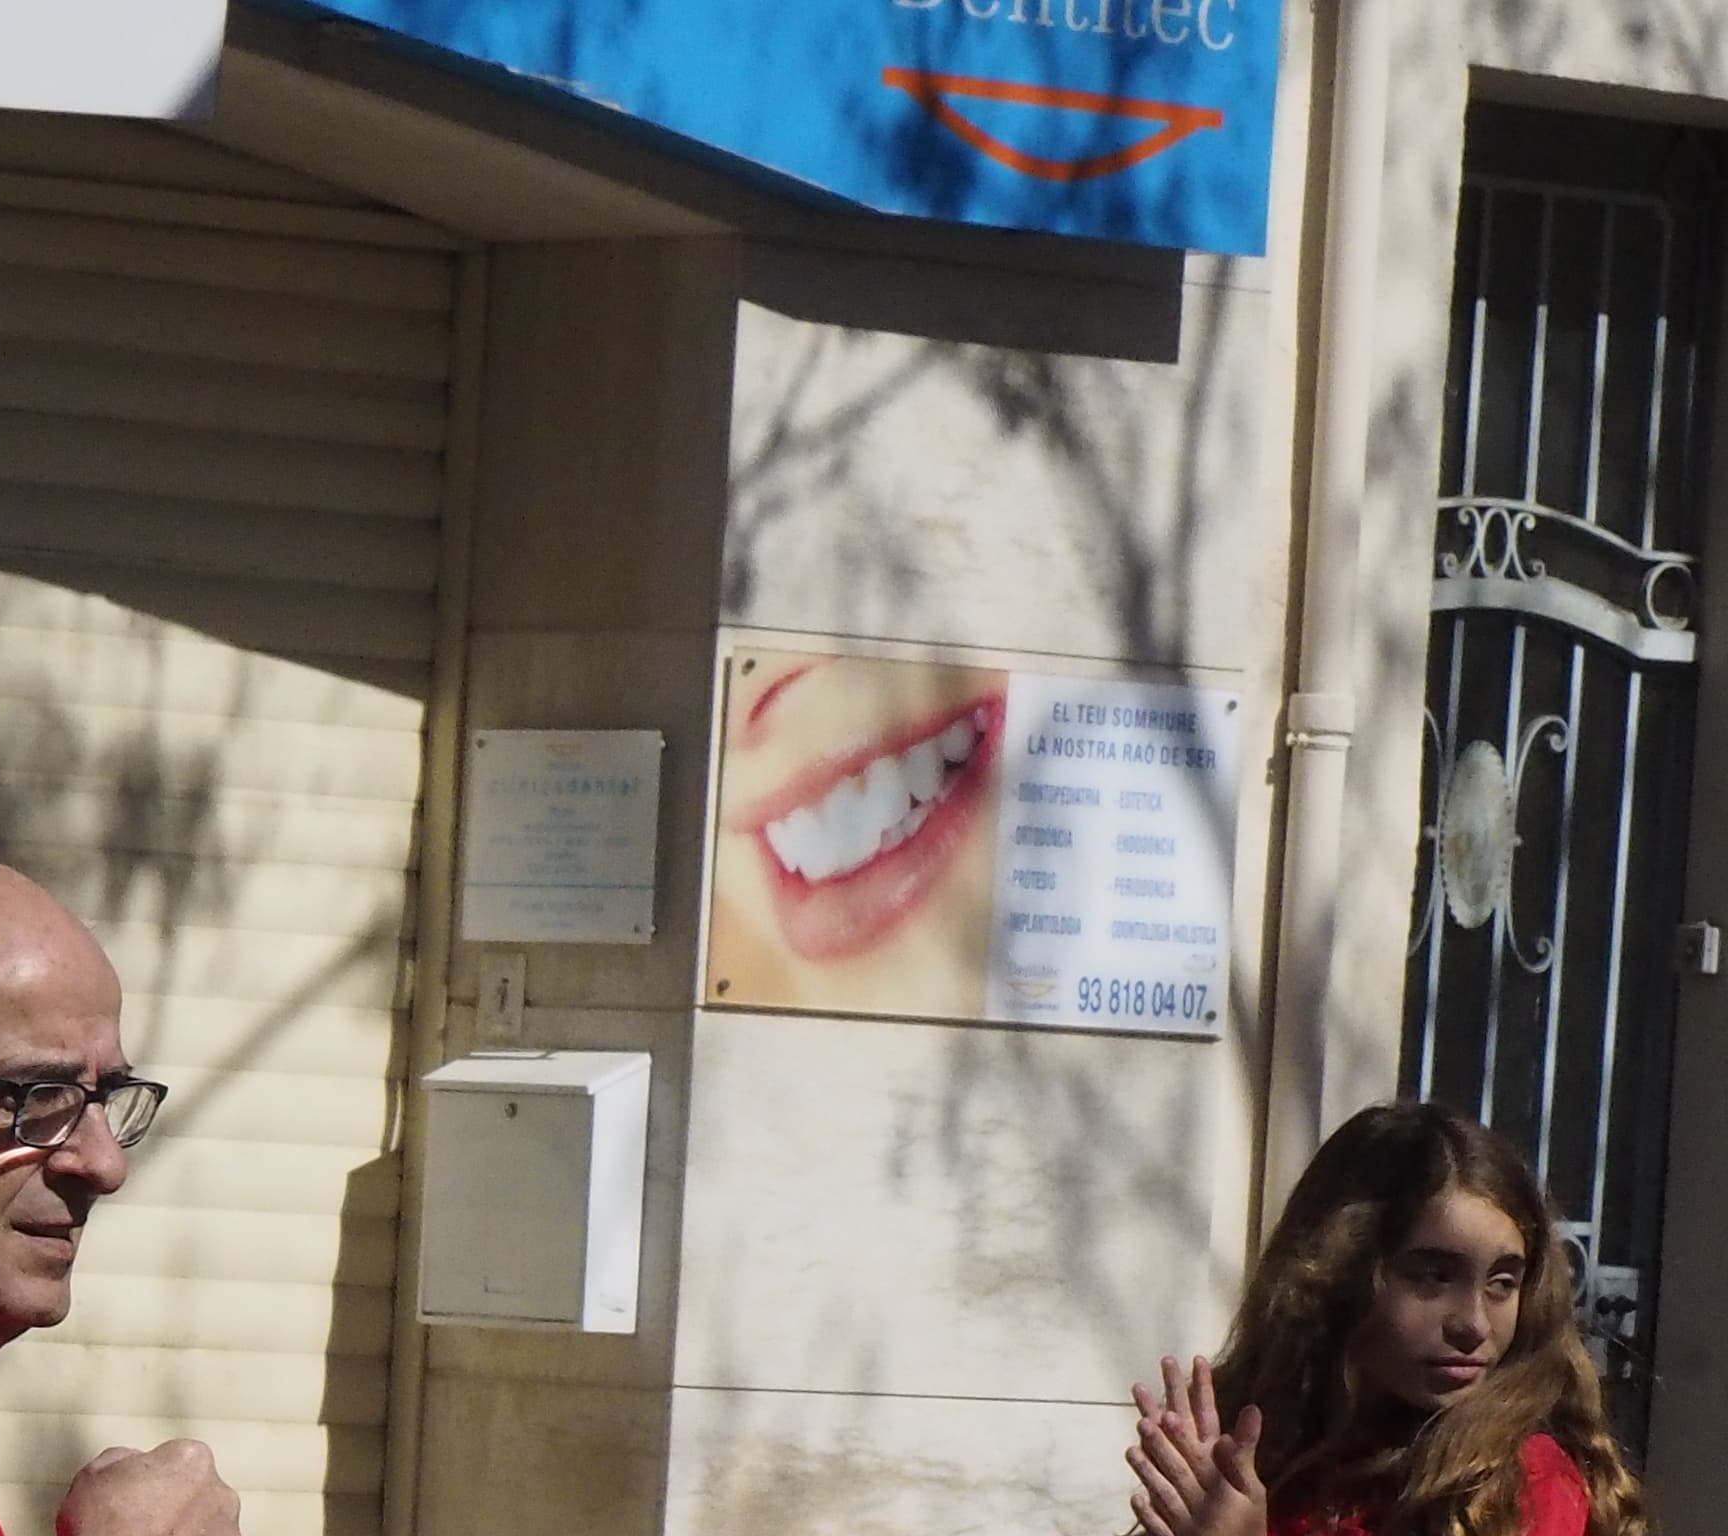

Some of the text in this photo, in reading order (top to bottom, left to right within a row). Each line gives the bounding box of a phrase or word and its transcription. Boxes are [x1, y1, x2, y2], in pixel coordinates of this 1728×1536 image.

[891, 0, 1235, 50] itec
[1052, 702, 1197, 734] EL TEU SOMRIURE
[1027, 734, 1046, 756] LA
[1052, 736, 1117, 760] NOSTRA
[1161, 746, 1180, 766] DE
[1185, 747, 1216, 770] SER
[1078, 976, 1208, 1020] 93 818 04 07
